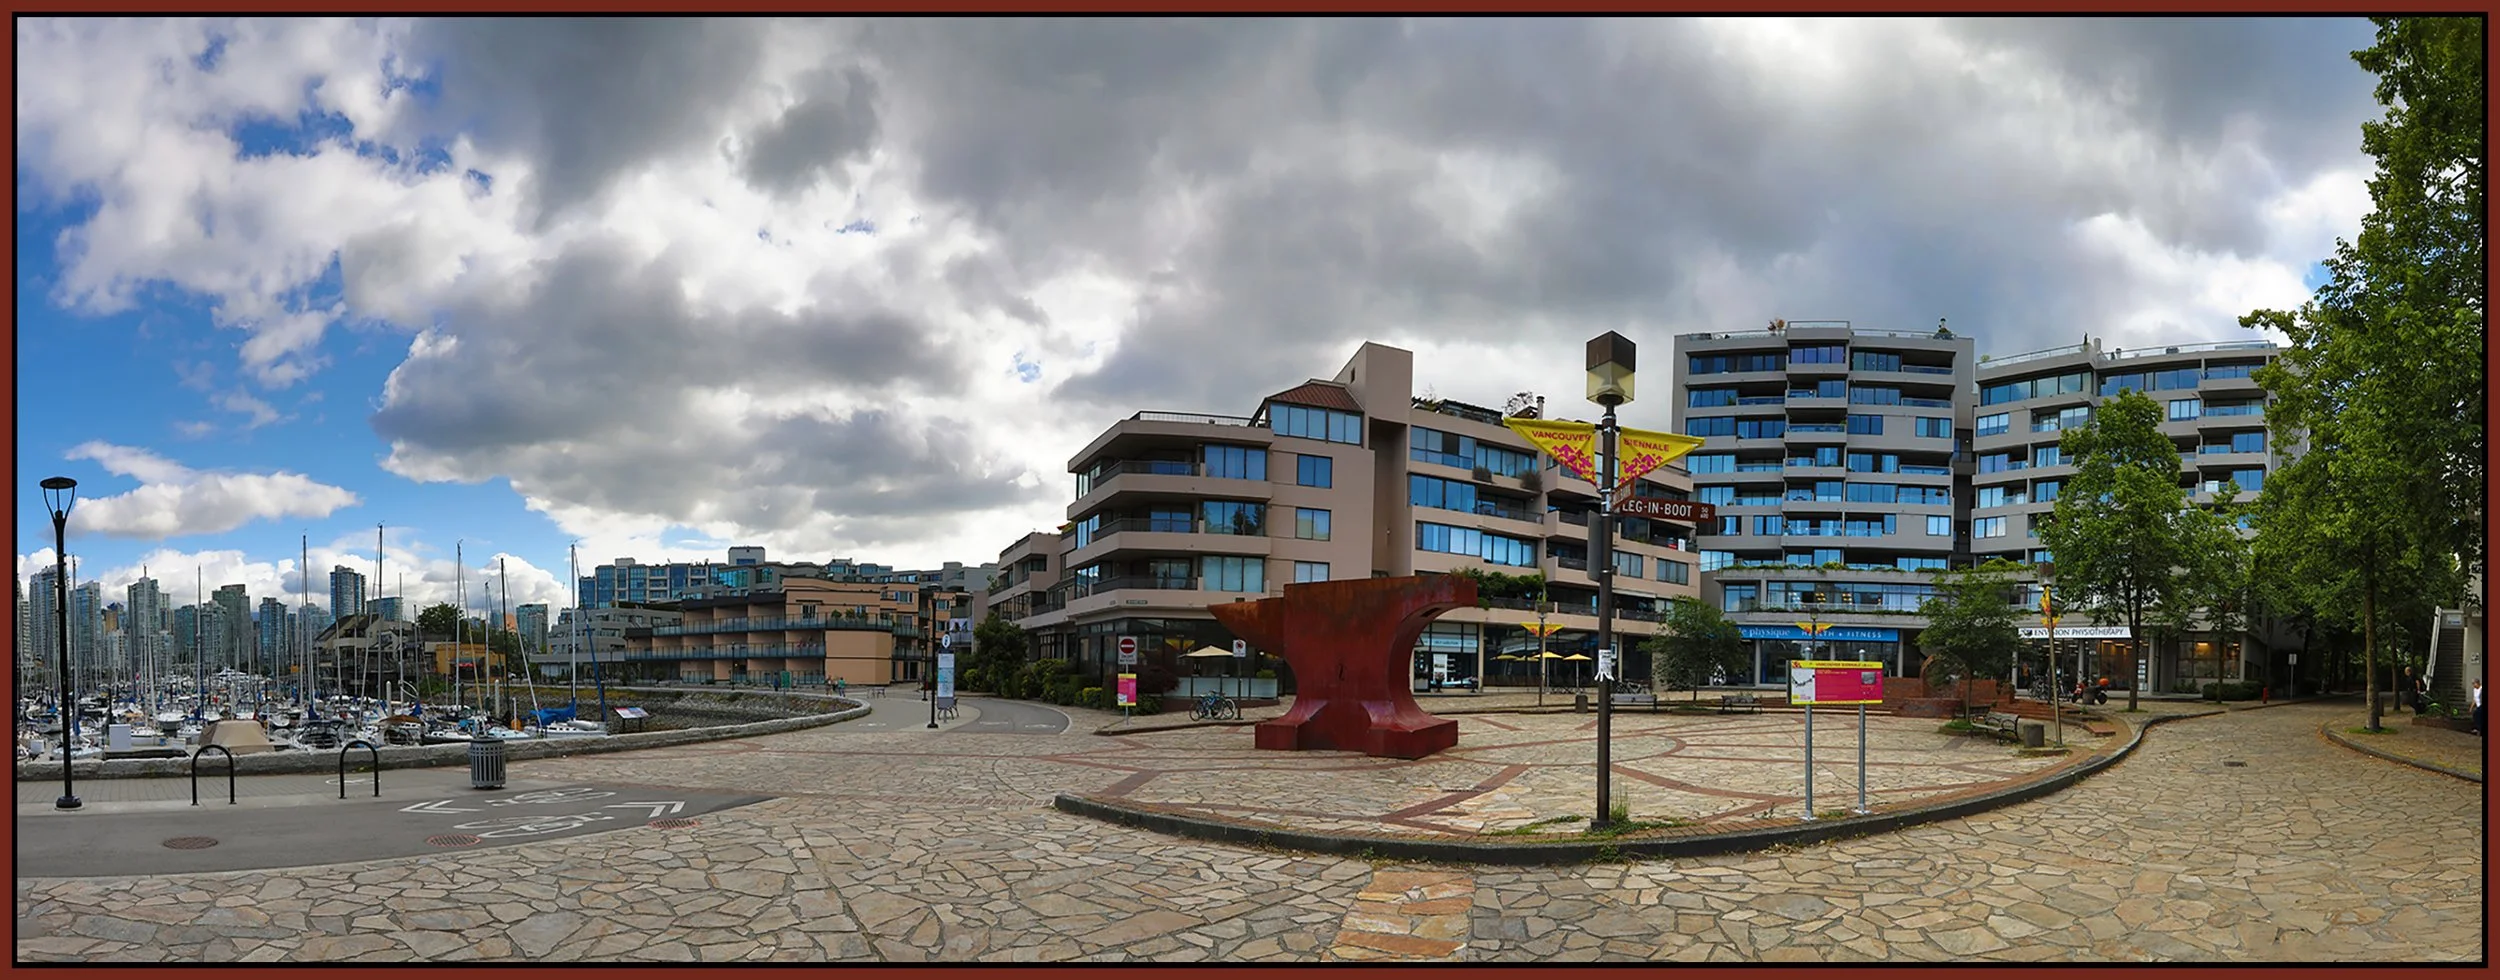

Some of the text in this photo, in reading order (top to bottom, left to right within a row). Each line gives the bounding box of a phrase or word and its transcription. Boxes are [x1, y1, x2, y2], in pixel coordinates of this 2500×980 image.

[1531, 430, 1592, 442] VANCOUVER
[1623, 437, 1670, 452] BIENNALE
[1622, 499, 1693, 518] LEG-IN-BOOT
[1749, 627, 1791, 638] physique
[1846, 630, 1882, 638] FITNESS
[2034, 627, 2124, 636] ENVION PHYSIOTHERAPY
